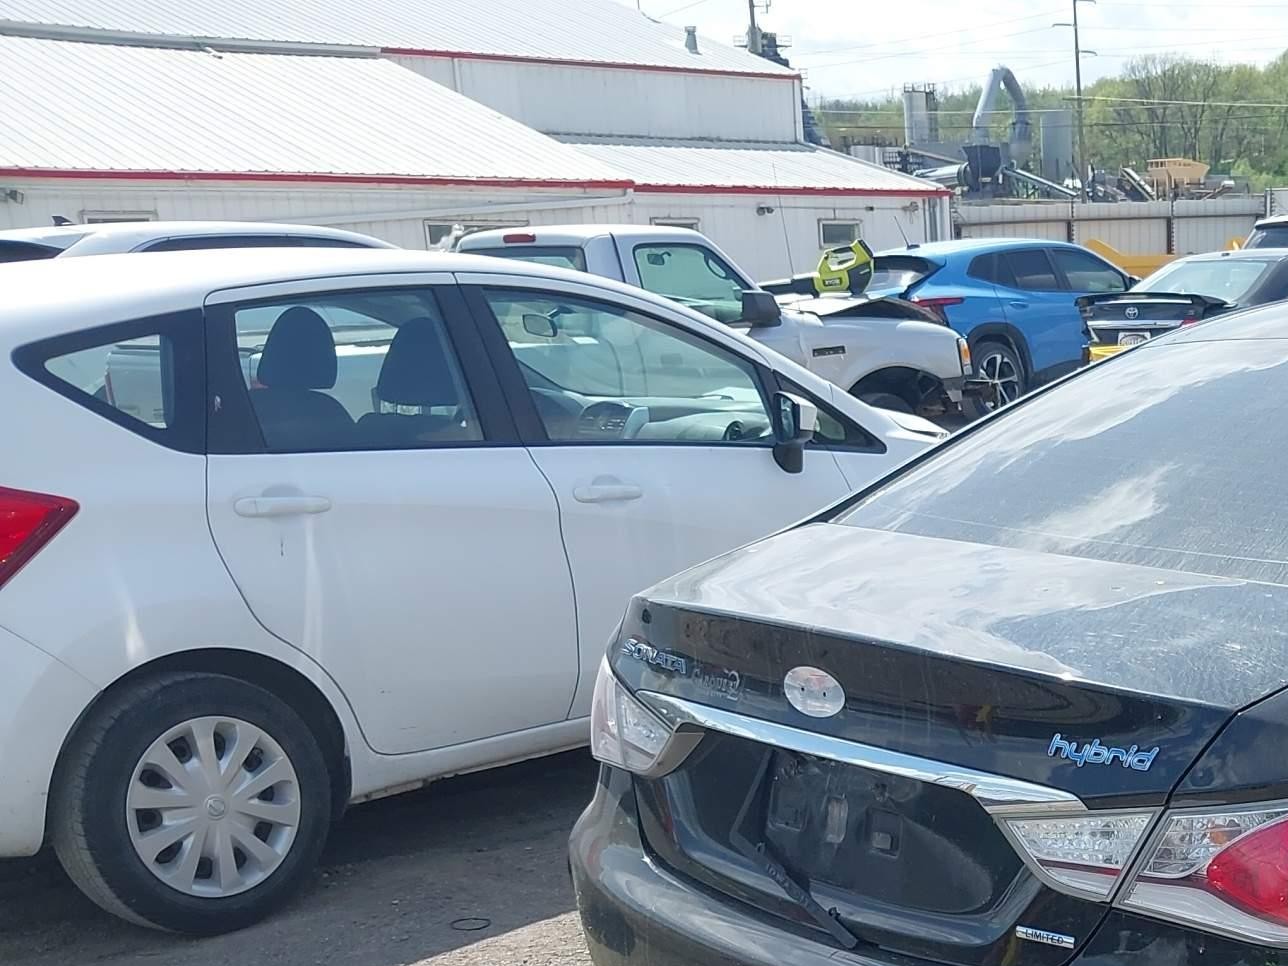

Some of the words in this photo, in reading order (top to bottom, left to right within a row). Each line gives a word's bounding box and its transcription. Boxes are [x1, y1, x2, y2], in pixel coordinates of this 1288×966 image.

[620, 639, 687, 674] SONATA
[1048, 733, 1160, 772] hybrid
[1024, 927, 1065, 945] LIMITED
